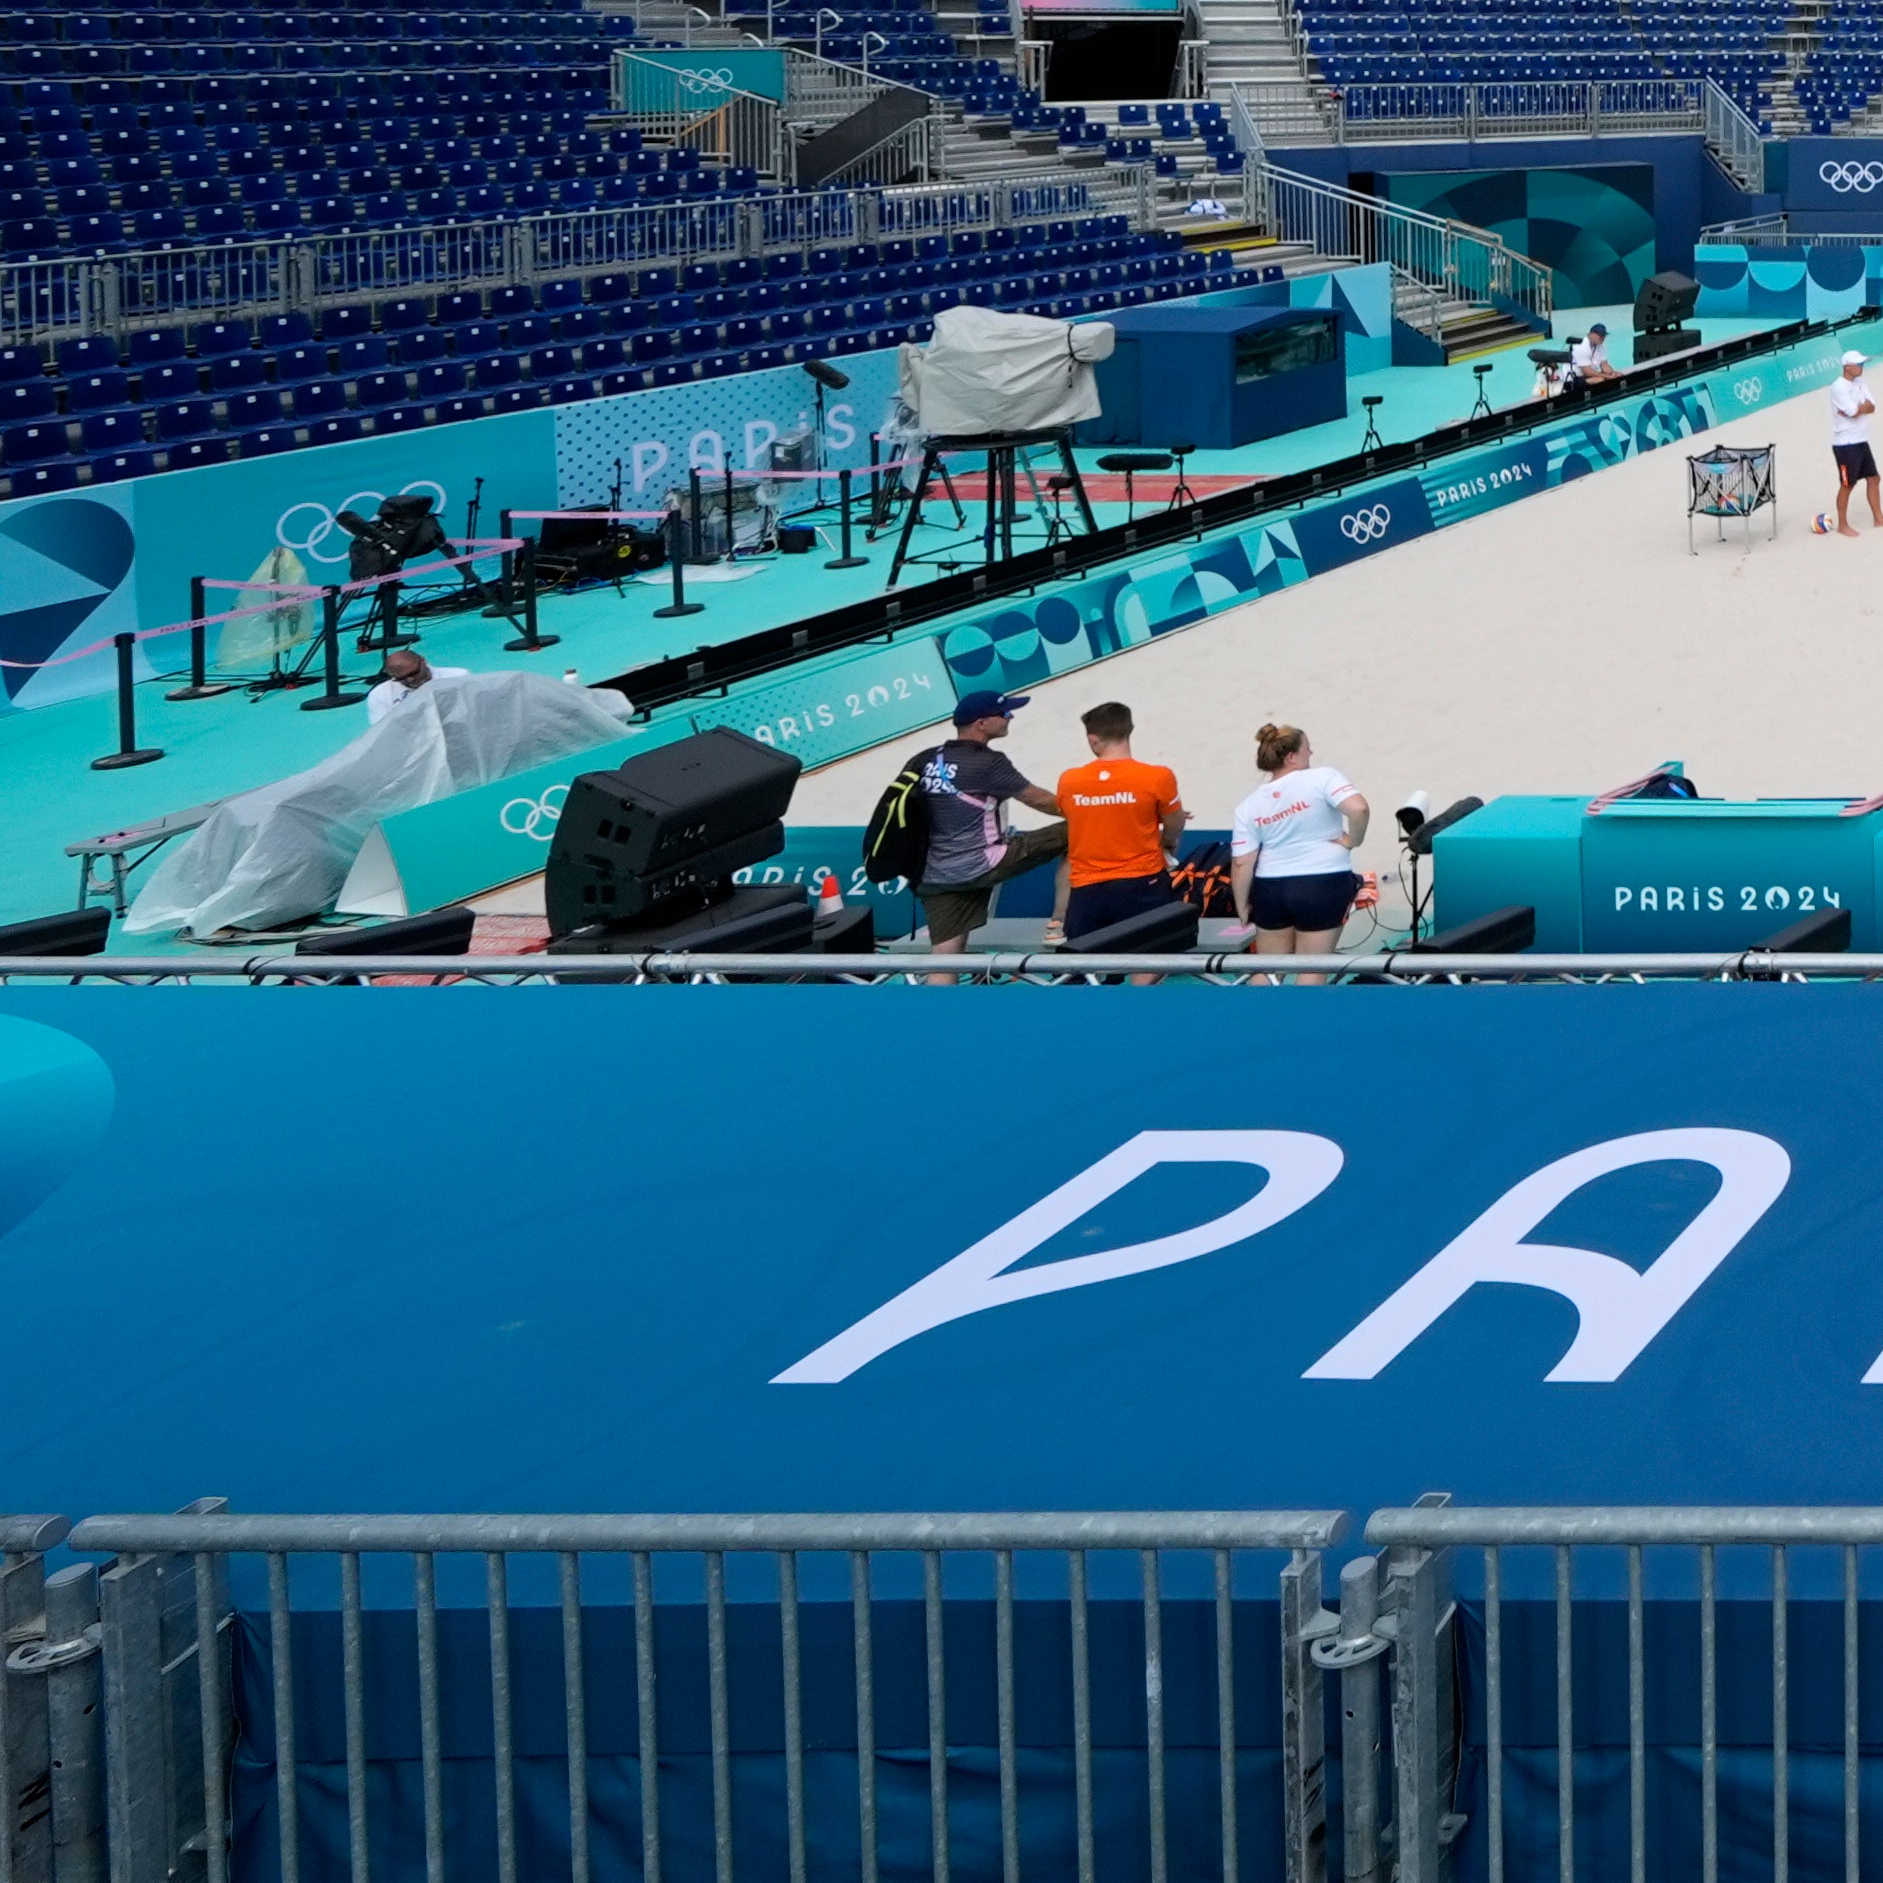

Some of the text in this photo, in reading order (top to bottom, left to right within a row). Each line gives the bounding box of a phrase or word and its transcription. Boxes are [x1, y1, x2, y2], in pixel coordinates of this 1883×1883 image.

[1489, 462, 1533, 490] 2024
[845, 672, 930, 718] 2024
[1072, 792, 1136, 806] TeamNL
[1254, 800, 1310, 829] TeamNL
[1740, 886, 1840, 911] 2024
